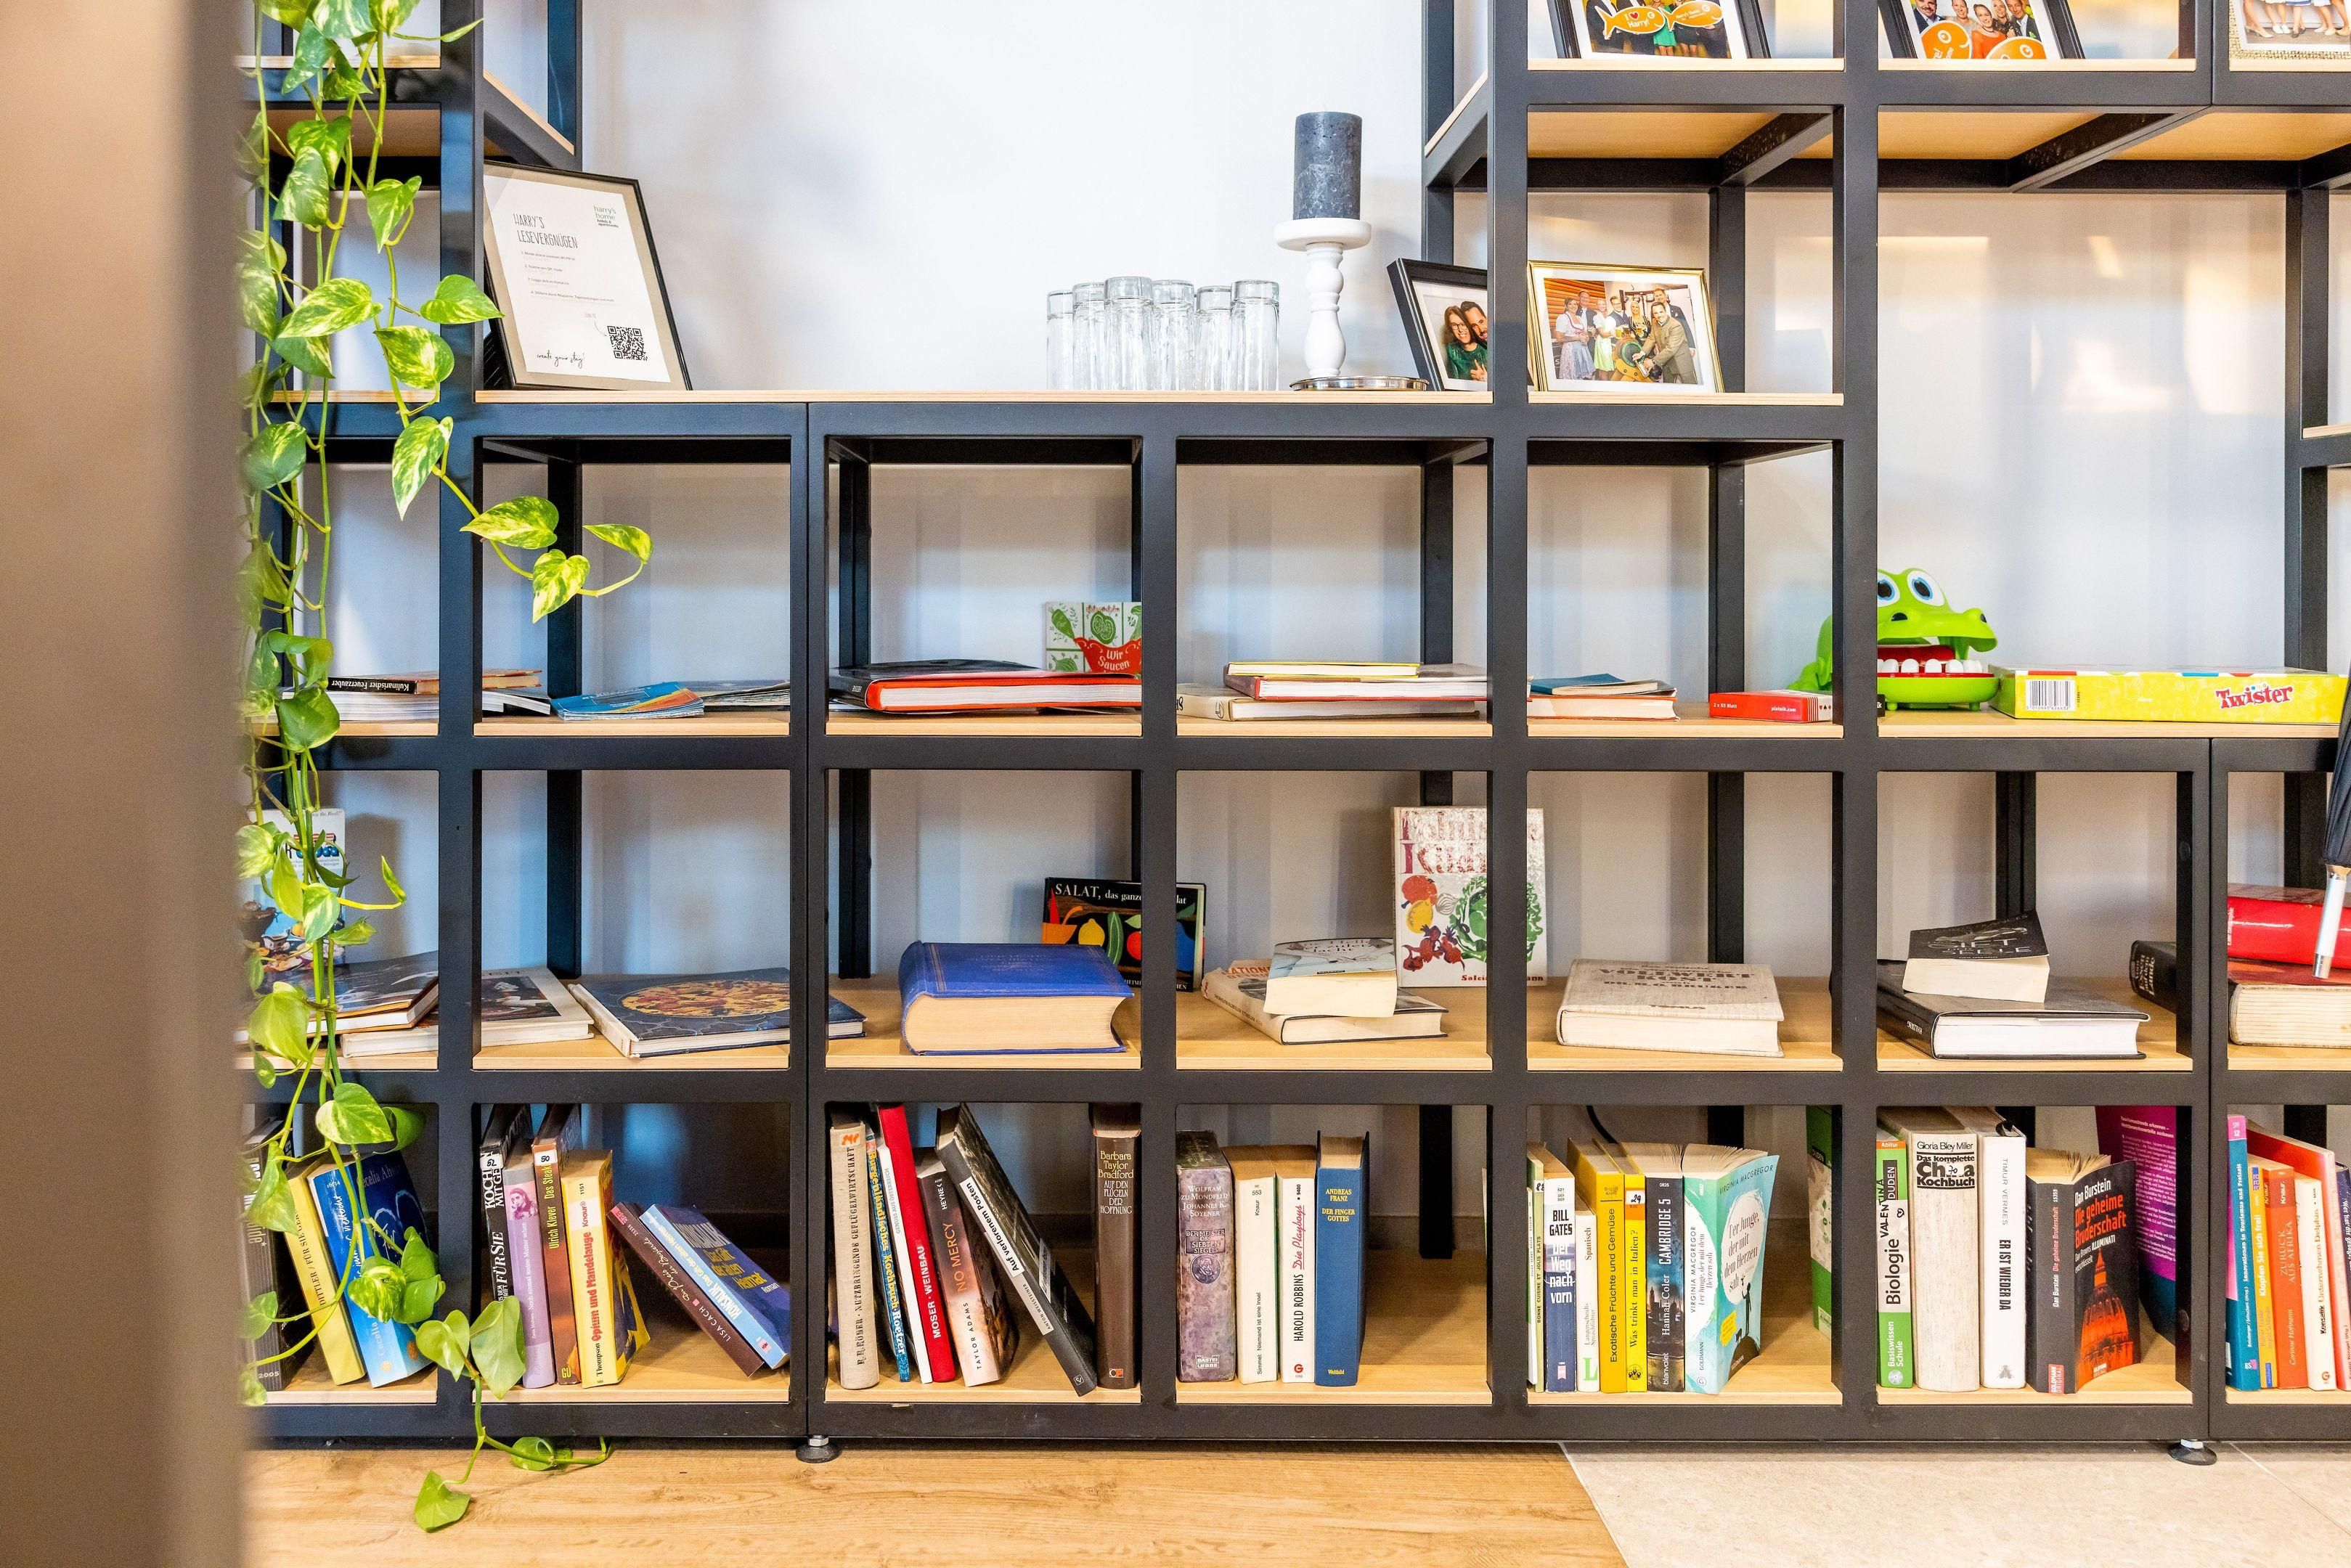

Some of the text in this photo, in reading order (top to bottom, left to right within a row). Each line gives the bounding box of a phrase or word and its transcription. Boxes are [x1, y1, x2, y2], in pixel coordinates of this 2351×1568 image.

[1628, 17, 1649, 29] Harry!
[594, 205, 616, 215] harry's
[595, 212, 616, 221] home
[517, 229, 578, 248] LESEVERGNÜGEN
[1098, 656, 1130, 671] Saucen
[1107, 649, 1124, 660] Wir
[331, 679, 410, 693] Kulinarischer Feuerzauber
[2214, 684, 2293, 710] Twister
[1055, 883, 1101, 900] SALAT,
[1105, 891, 1119, 900] das
[1599, 968, 1755, 979] VOLLWERT
[1637, 974, 1716, 983] KOST
[1100, 1151, 1131, 1161] Barbara
[1917, 1141, 1973, 1151] Gloria Bley Miller
[1103, 1160, 1128, 1170] Taylor
[1934, 1155, 1975, 1164] komplette
[1098, 1169, 1134, 1179] Bradford
[1104, 1180, 1128, 1189] AUF DEN
[1719, 1164, 1774, 1195] VIRGINIA MACGREGOR
[1887, 1166, 1896, 1200] DUDEN
[1917, 1176, 1975, 1188] Kochbuch
[847, 1147, 860, 1240] GEFLÜGELWIRTSCHAFT
[937, 1188, 948, 1210] HEYNE
[1104, 1188, 1128, 1198] FLÜGELN
[1188, 1185, 1222, 1193] WOLFRAM
[1325, 1188, 1352, 1196] ANDREAS
[2074, 1178, 2111, 1208] Dan Burstein
[2278, 1181, 2287, 1204] Knaur.
[1099, 1205, 1133, 1214] HOFFNUNG
[1109, 1198, 1124, 1206] DER
[1877, 1178, 1890, 1238] VALENTINA
[2074, 1195, 2124, 1228] Die geheime
[966, 1182, 1019, 1272] Auf verlorenem Posten
[1552, 1209, 1569, 1222] BILL
[547, 1206, 560, 1249] Ulrich Klever
[1549, 1223, 1573, 1236] GATES
[1608, 1208, 1616, 1251] Gemüse
[1658, 1208, 1671, 1265] CAMBRIDGE
[2075, 1212, 2127, 1249] Bruderschaft
[490, 1231, 505, 1256] SIE
[867, 1150, 906, 1356] Burgenländisches Kochbuch Roetzer
[1584, 1227, 1594, 1261] Spanisch
[2277, 1230, 2287, 1276] ZURÜCK
[2284, 1221, 2296, 1283] AUS AFRIKA
[582, 1231, 597, 1289] Mandelauge
[945, 1222, 967, 1292] NO MERCY
[1551, 1256, 1571, 1273] Weg
[2254, 1214, 2267, 1297] Klopfen Sie sich frei!
[492, 1256, 508, 1283] FÜR
[732, 1271, 768, 1291] Heimat
[1291, 1204, 1305, 1342] HAROLD ROBBINS Die Playboys
[1549, 1273, 1573, 1288] nach
[1885, 1238, 1904, 1305] Biologie
[2000, 1239, 2011, 1311] ER IST WIEDER DA
[2315, 1244, 2326, 1303] Unternehmen
[587, 1289, 598, 1310] und
[761, 1282, 780, 1294] Roman
[916, 1246, 942, 1339] MOSER WEINBAU
[1549, 1291, 1573, 1304] vorn
[1022, 1283, 1051, 1330] ANTON WEISSTEINER
[1661, 1274, 1671, 1336] Hannah Coler
[698, 1305, 731, 1343] LISA CACH
[2287, 1308, 2296, 1339] Hofmann
[963, 1302, 982, 1370] TAYLOR ADAMS
[1609, 1314, 1618, 1363] Exotische
[595, 1343, 604, 1376] Thompson
[257, 1371, 280, 1379] 2005
[561, 1368, 572, 1379] GU
